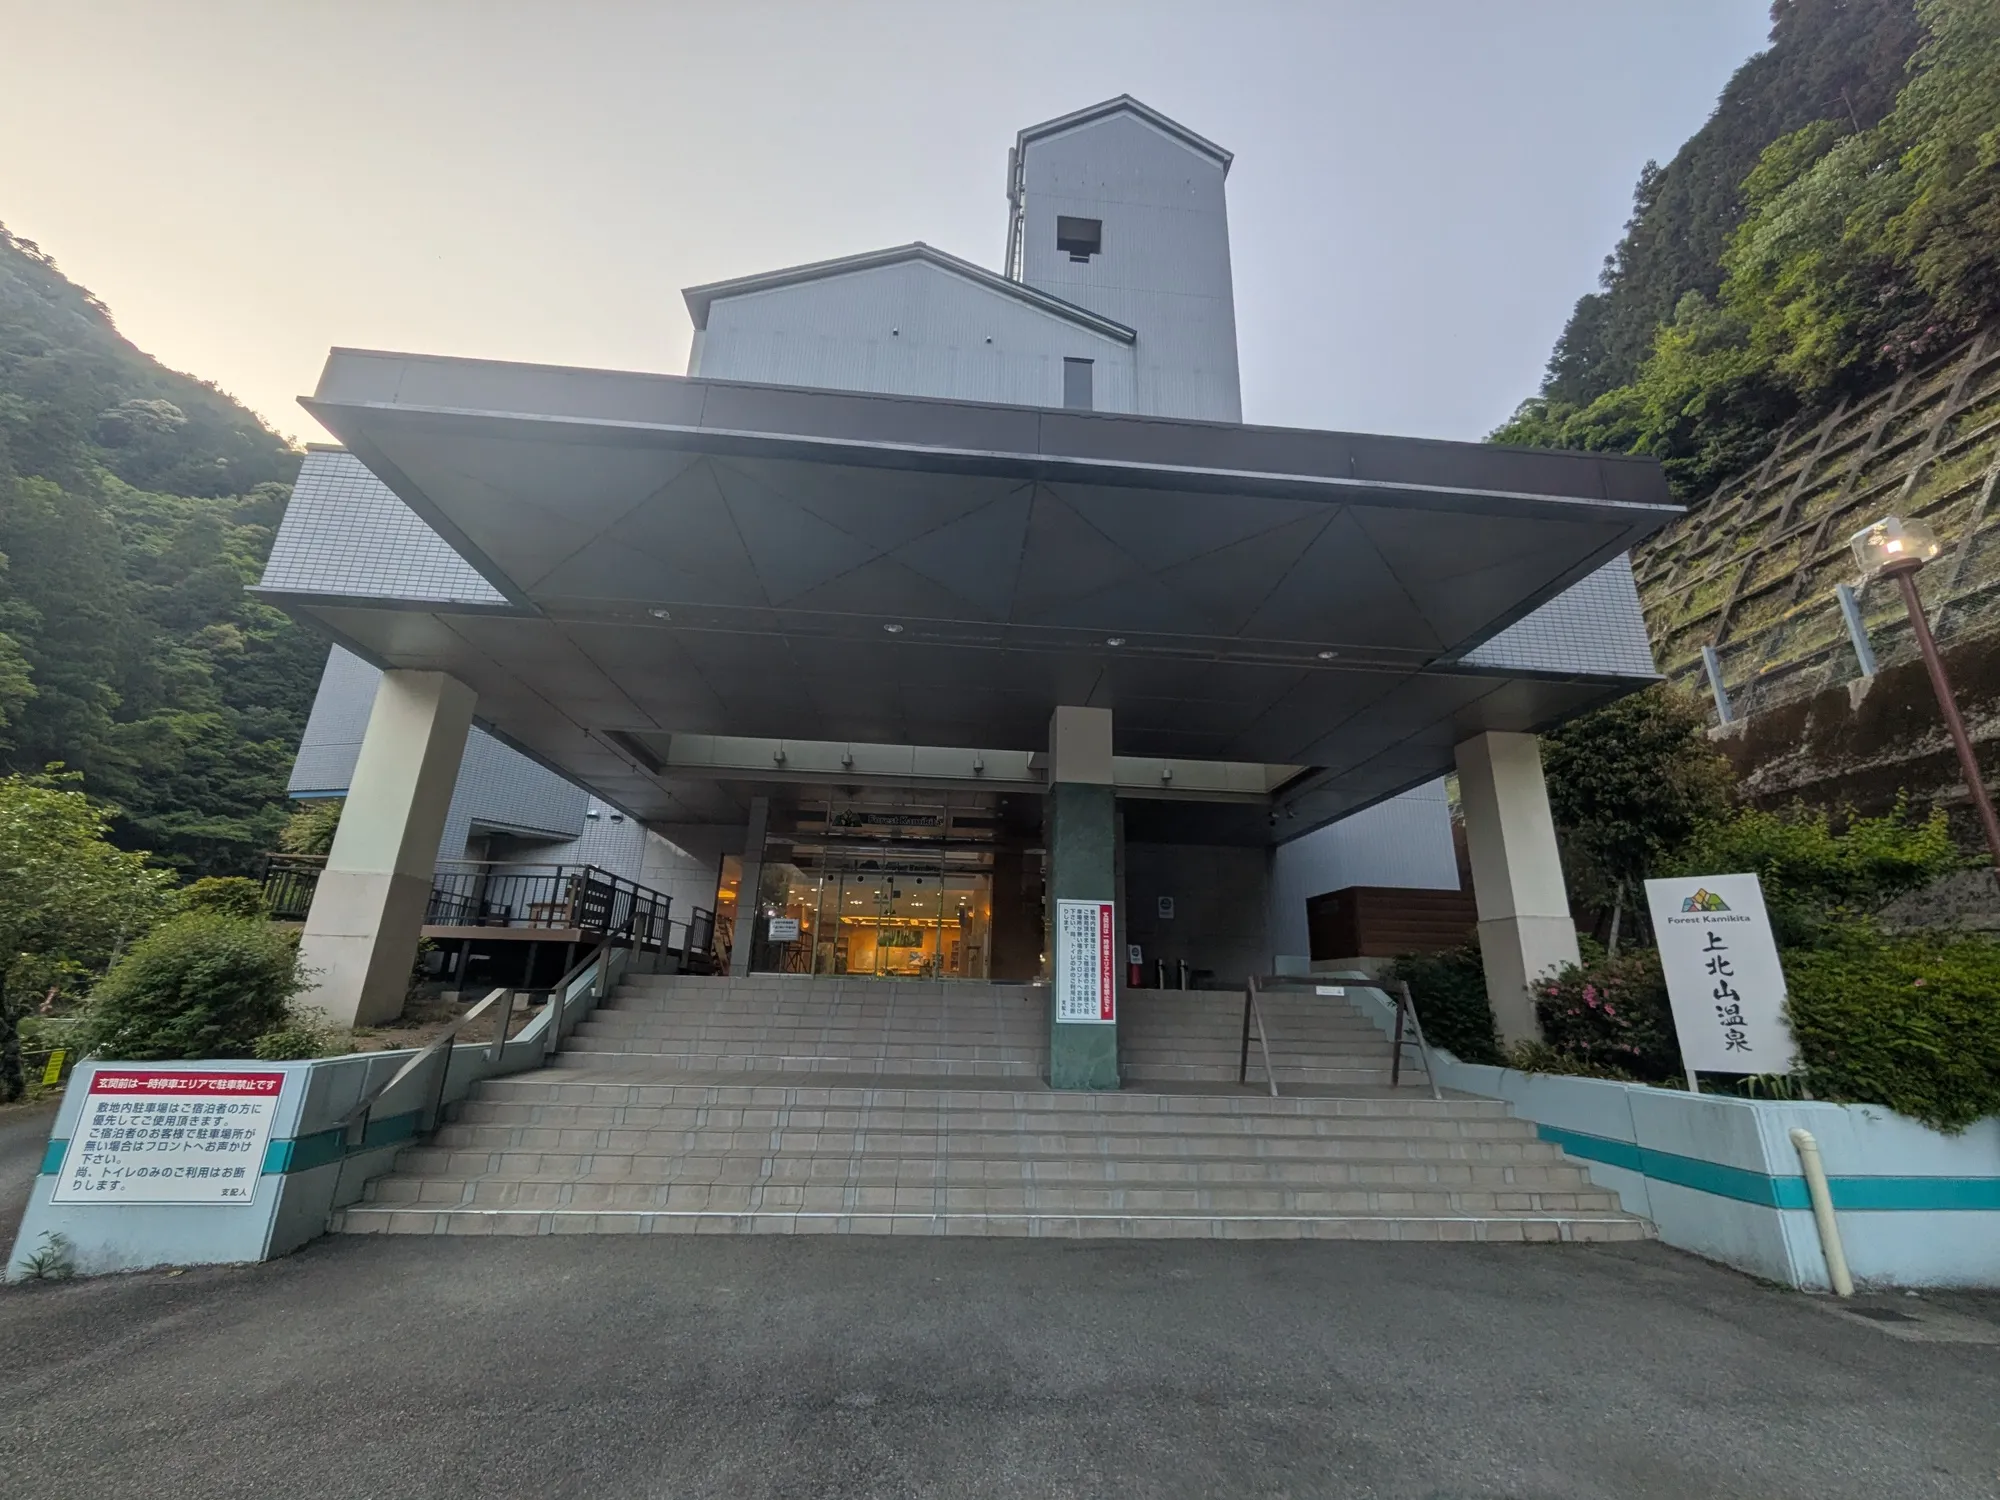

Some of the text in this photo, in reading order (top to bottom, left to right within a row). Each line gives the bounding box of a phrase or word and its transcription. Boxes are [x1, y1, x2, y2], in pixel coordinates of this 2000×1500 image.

[1668, 915, 1751, 924] Forest Kamikita
[1702, 931, 1753, 1053] 上北山温泉
[97, 1078, 276, 1090] 玄関前は一時停車エリアで駐車禁止です
[96, 1102, 262, 1114] 敷地内駐車場はご宿泊者の方に
[92, 1115, 229, 1127] 優先してご使用頂きます。
[89, 1128, 256, 1139] ご宿泊者のお客様で駐車場所が
[84, 1140, 252, 1152] 無い場合はフロントへお声かけ
[82, 1153, 121, 1165] 下さい。
[72, 1180, 125, 1191] りします。
[220, 1188, 247, 1196] 支配人
